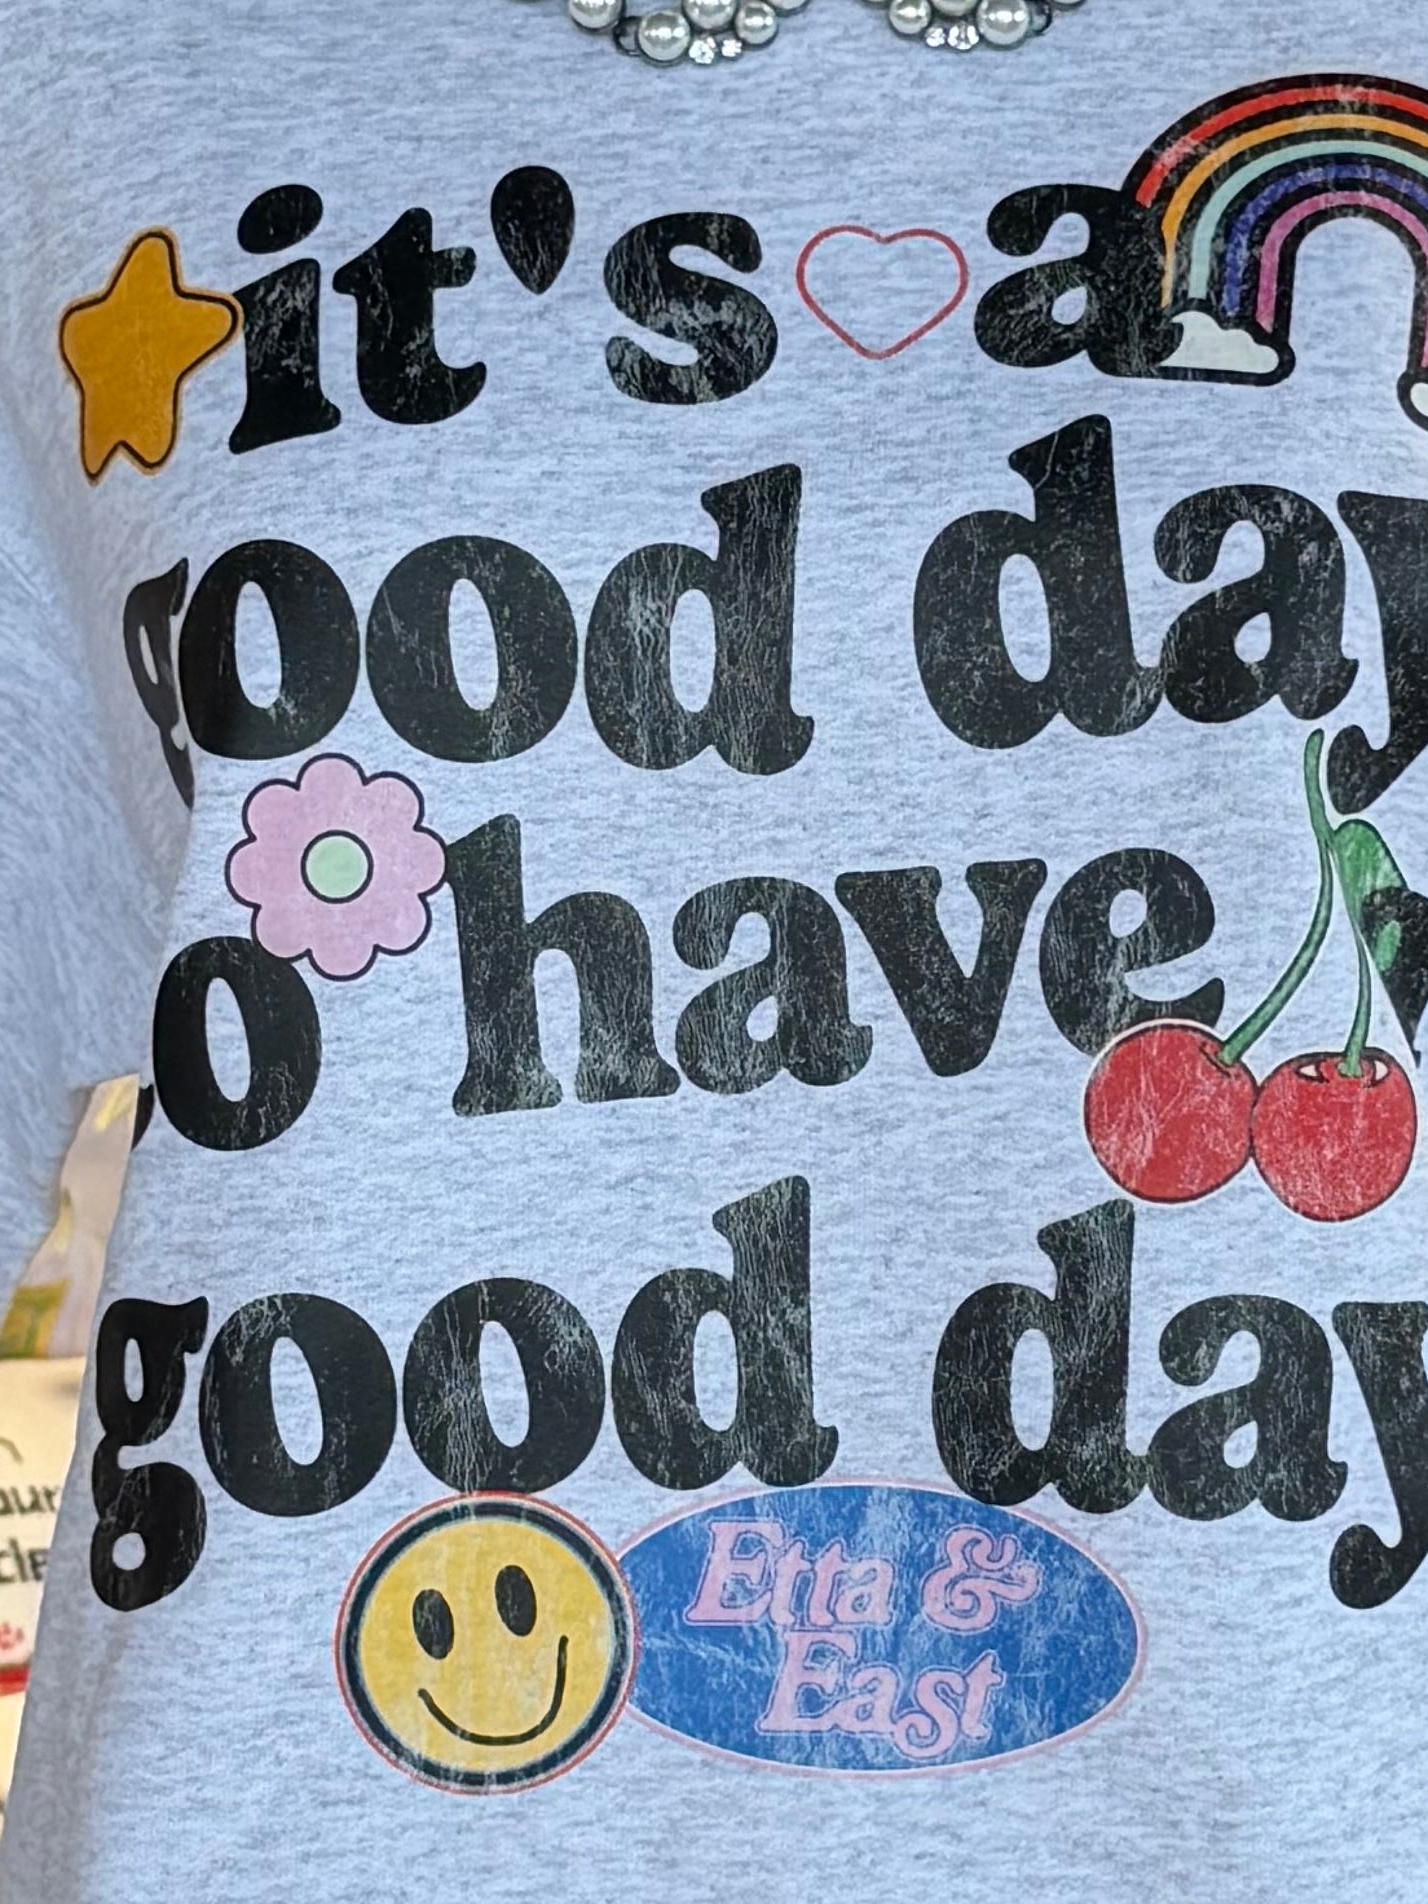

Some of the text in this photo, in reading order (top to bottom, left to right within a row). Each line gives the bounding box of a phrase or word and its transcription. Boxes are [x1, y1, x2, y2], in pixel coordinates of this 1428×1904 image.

[228, 165, 1183, 458] it's a
[130, 935, 323, 1152] o
[444, 812, 1226, 1118] have
[88, 1174, 838, 1612] good
[683, 1518, 1045, 1635] Etta &
[755, 1628, 1006, 1760] East
